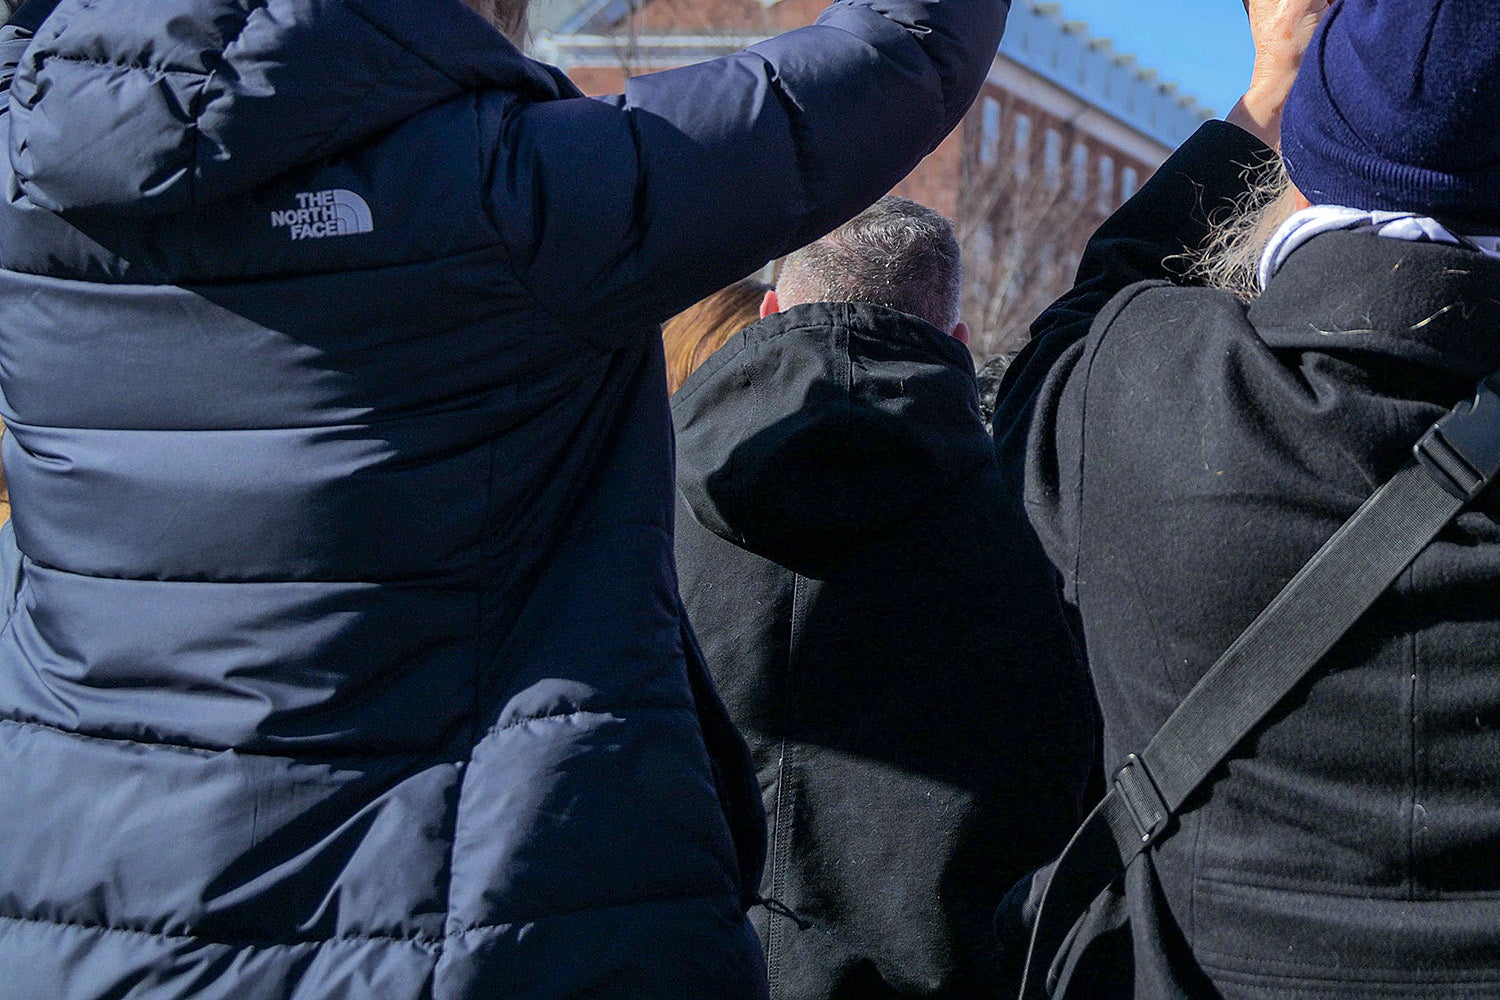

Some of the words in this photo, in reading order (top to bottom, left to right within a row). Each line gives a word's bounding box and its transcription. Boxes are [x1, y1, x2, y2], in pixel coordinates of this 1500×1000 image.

[294, 189, 334, 208] THE
[270, 204, 337, 227] NORTH
[290, 220, 338, 241] FACE
